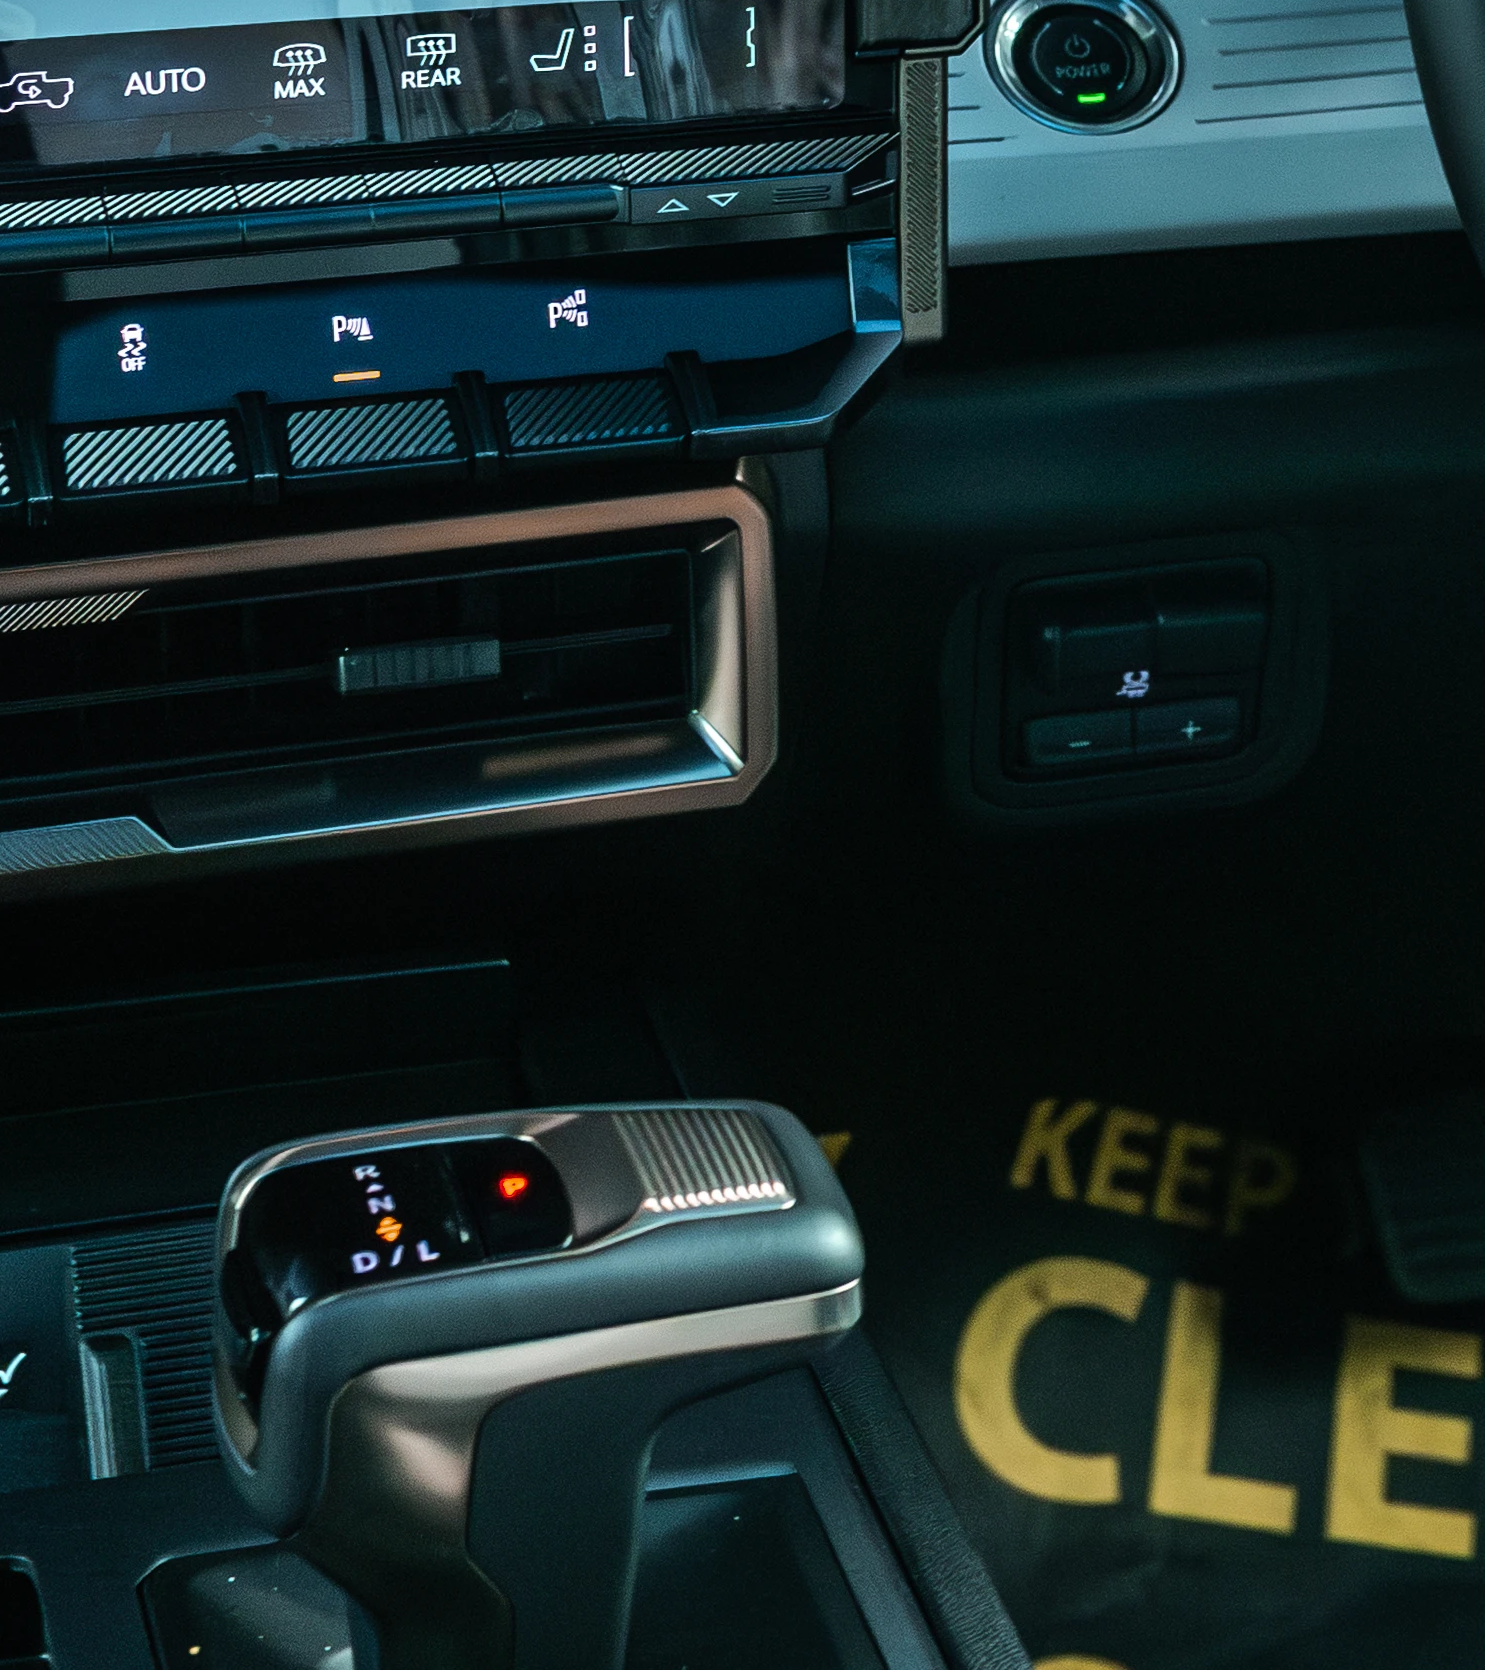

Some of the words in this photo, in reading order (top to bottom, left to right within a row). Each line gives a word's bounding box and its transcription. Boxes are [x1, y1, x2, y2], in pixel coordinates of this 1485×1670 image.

[124, 66, 207, 98] AUTO
[273, 77, 326, 100] MAX
[400, 66, 463, 90] REAR
[120, 356, 147, 373] OFF
[353, 1164, 381, 1181] R
[1010, 1098, 1295, 1236] KEEP
[367, 1195, 397, 1215] N
[349, 1250, 381, 1275] D
[416, 1239, 442, 1263] L
